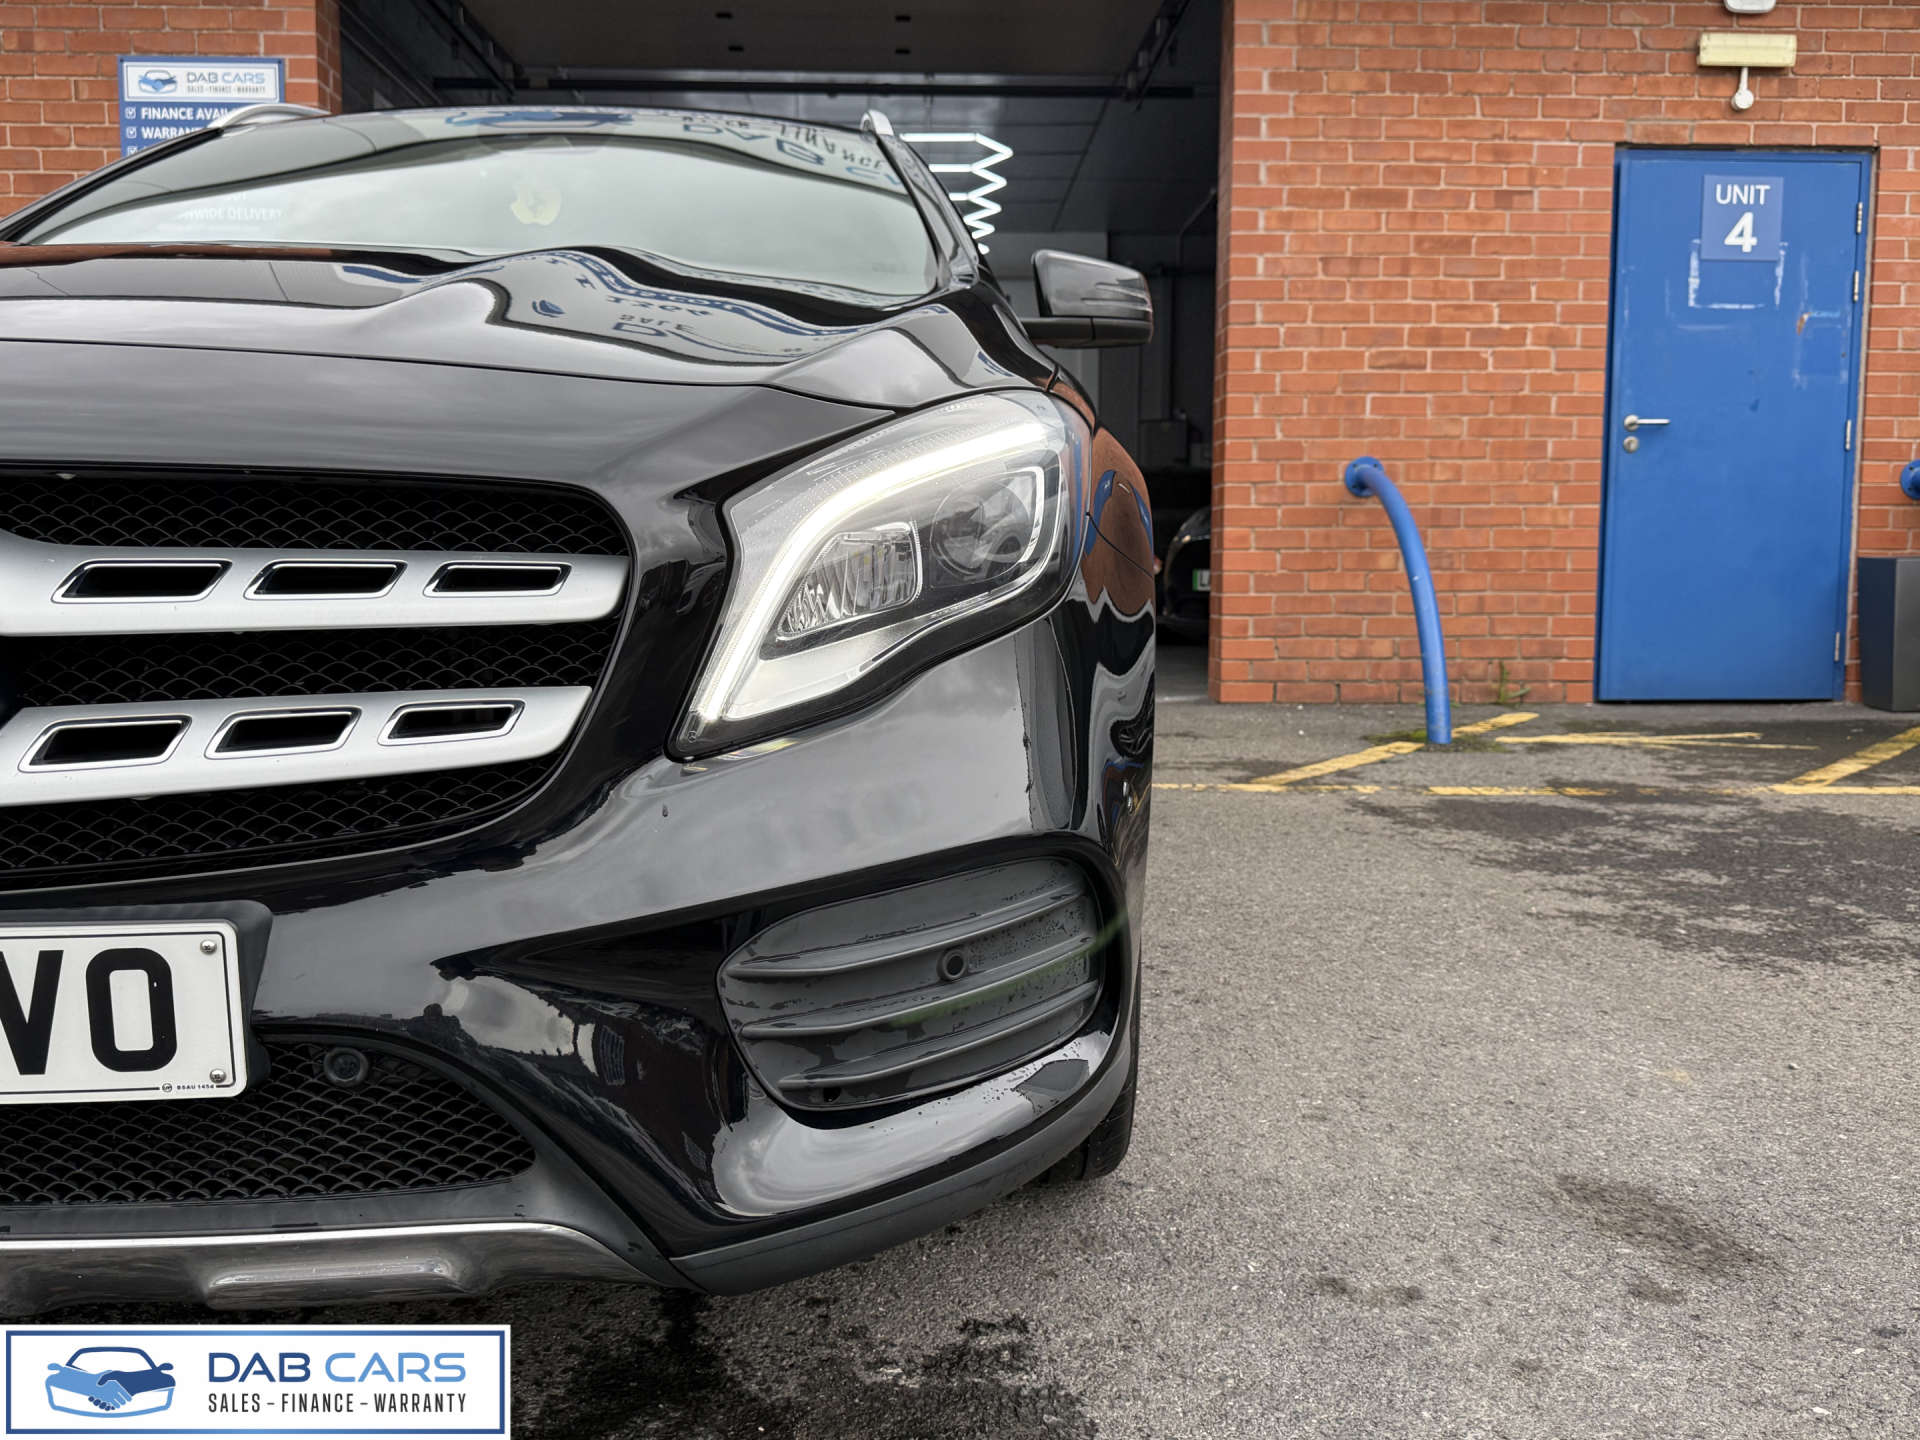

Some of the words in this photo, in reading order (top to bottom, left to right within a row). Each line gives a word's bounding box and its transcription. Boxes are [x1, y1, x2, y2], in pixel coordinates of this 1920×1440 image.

[186, 71, 219, 83] DAB
[222, 72, 265, 84] CARS
[141, 107, 194, 120] FINANCE
[1716, 184, 1771, 205] UNIT
[1724, 211, 1757, 253] 4
[0, 947, 178, 1076] VO
